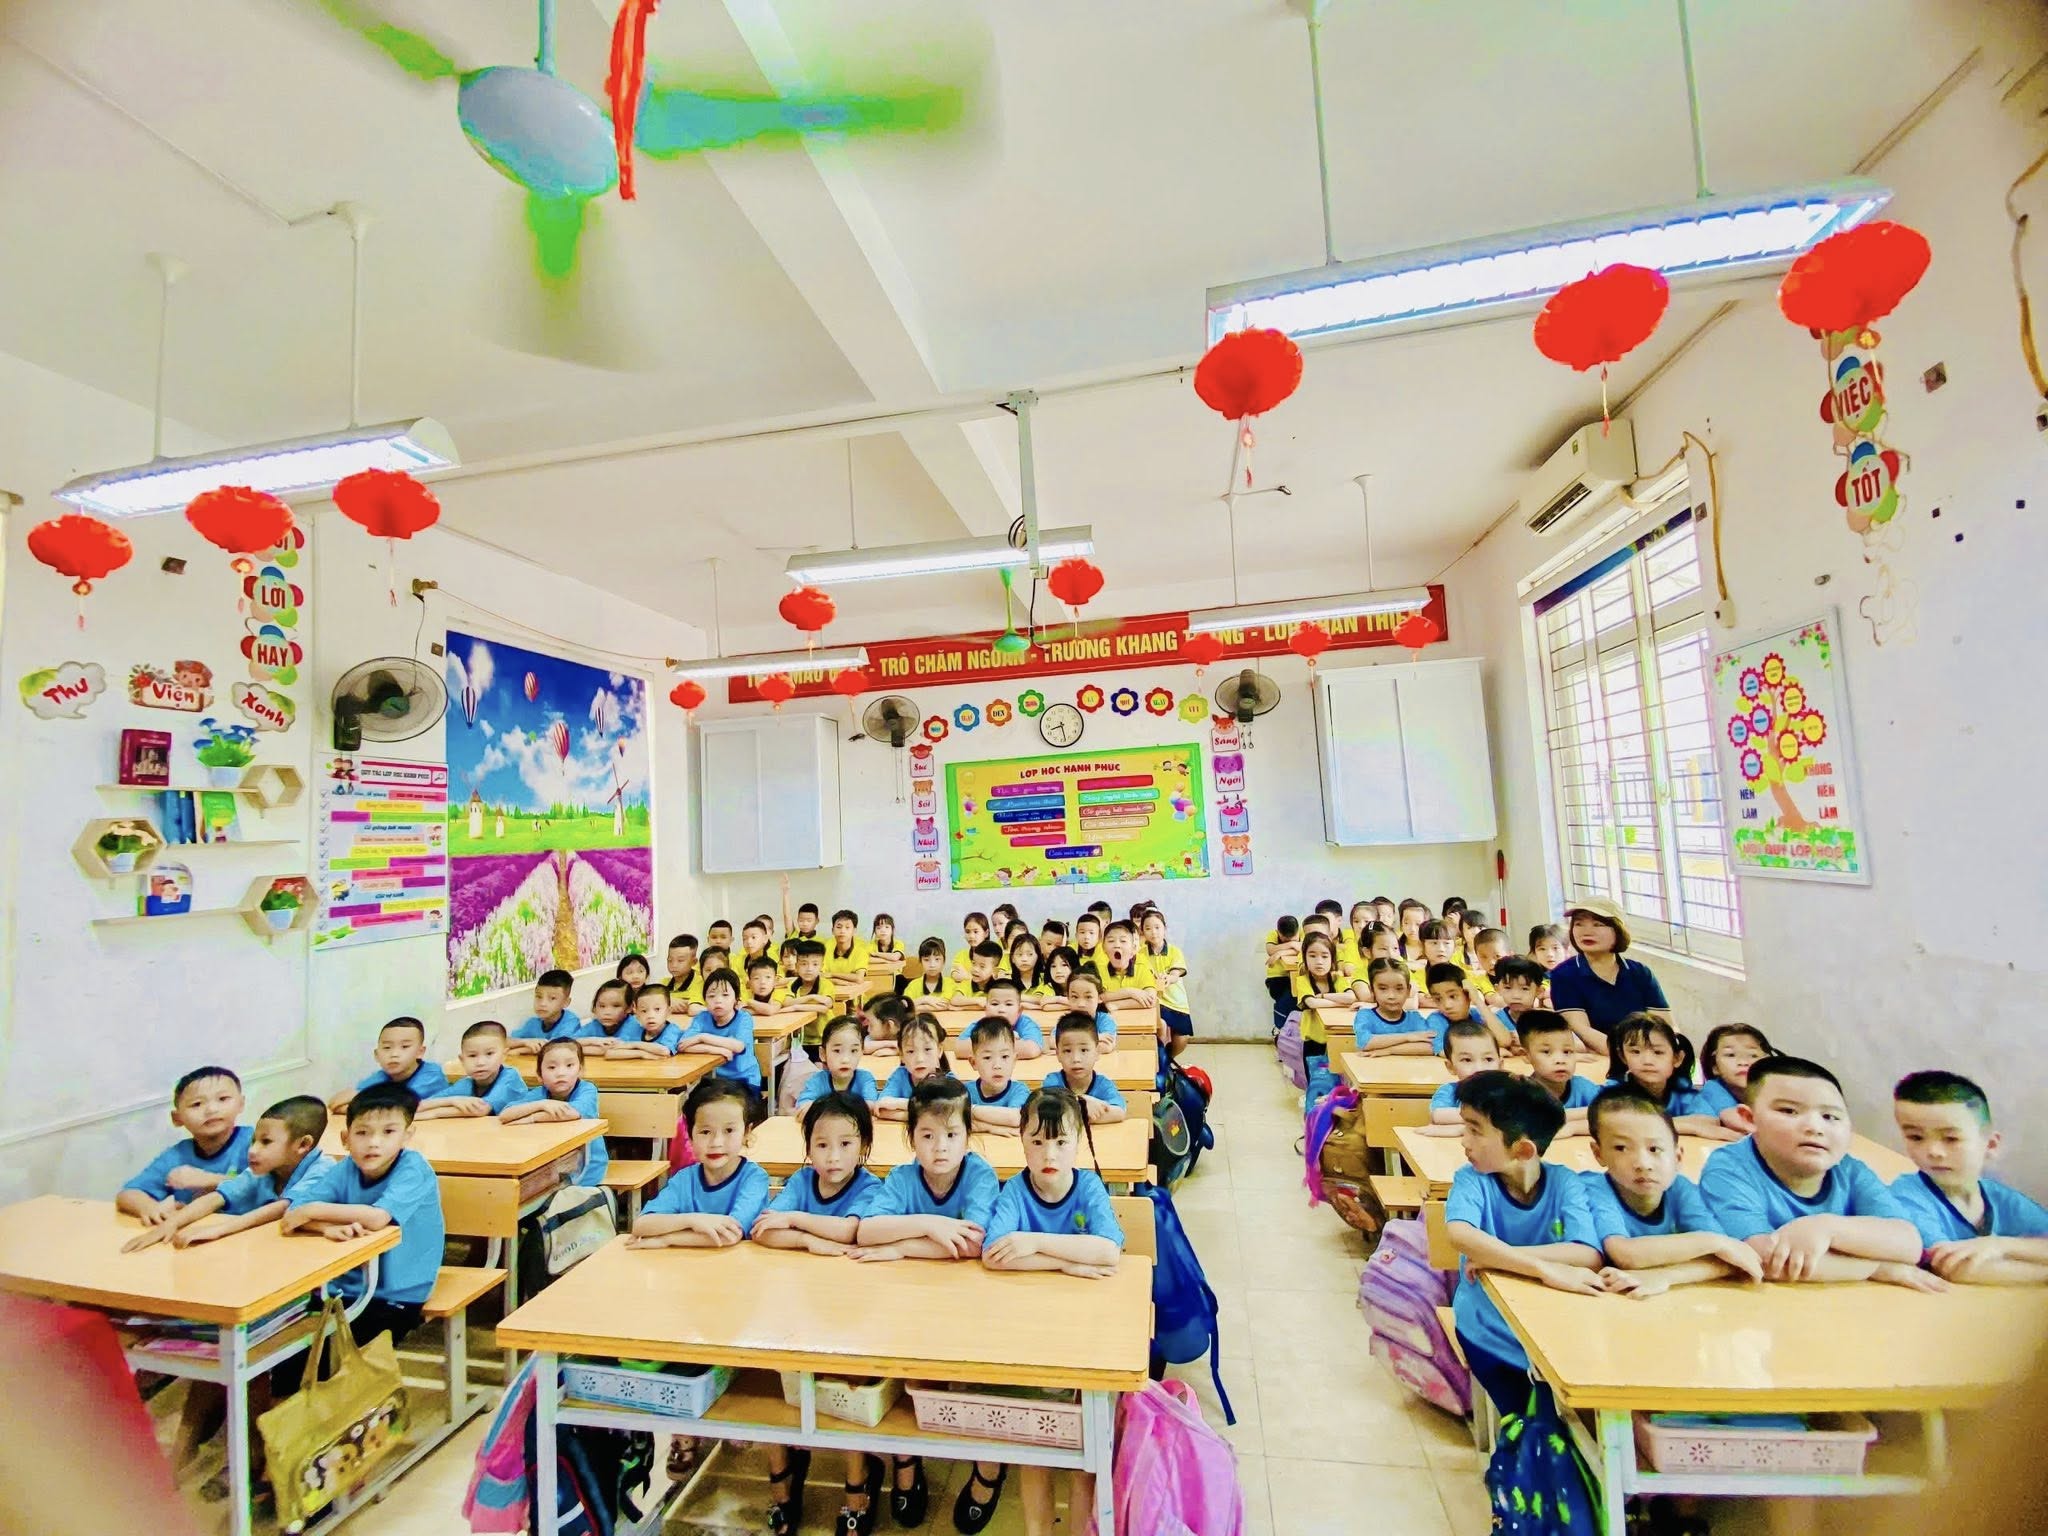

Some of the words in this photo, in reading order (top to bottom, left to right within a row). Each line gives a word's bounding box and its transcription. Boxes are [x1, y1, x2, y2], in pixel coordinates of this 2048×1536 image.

[1852, 461, 1881, 507] TỐT
[257, 643, 288, 667] HAY
[880, 652, 910, 677] TRÒ
[914, 650, 962, 675] CHĂM
[1116, 630, 1178, 656] KHANG
[241, 691, 285, 727] Xanh
